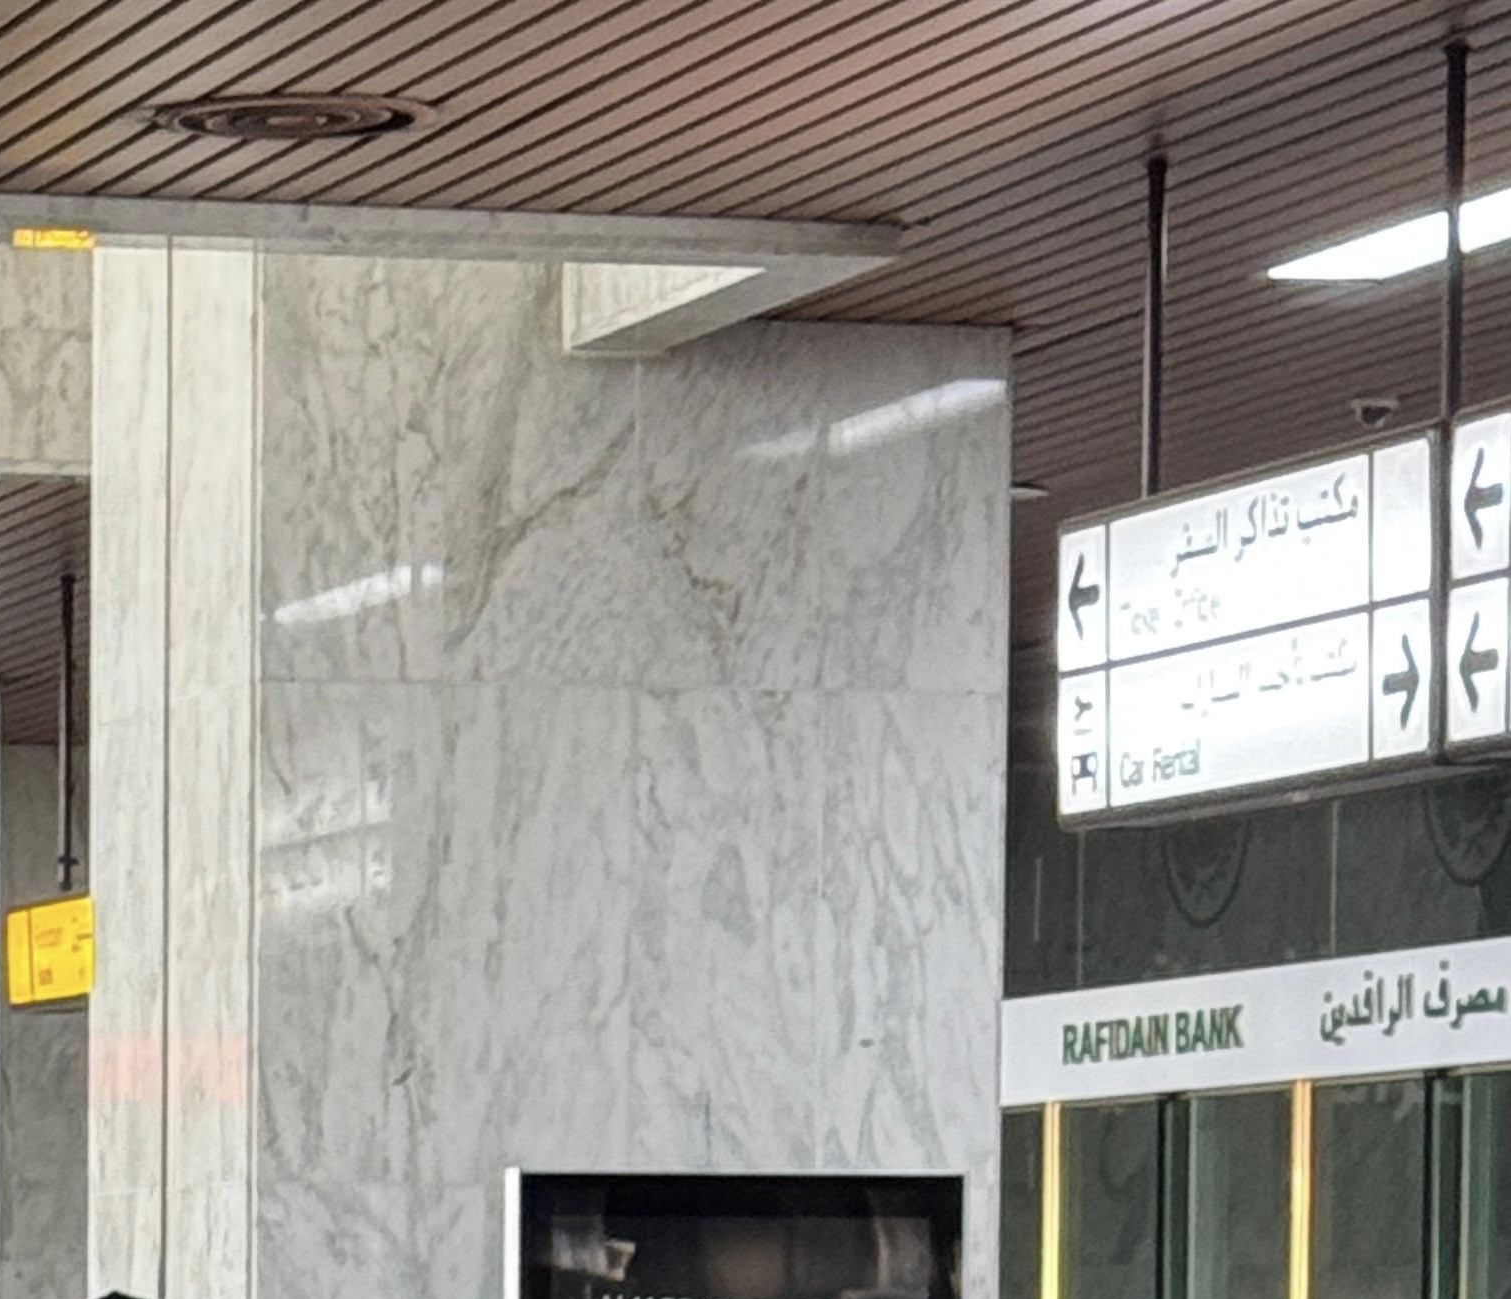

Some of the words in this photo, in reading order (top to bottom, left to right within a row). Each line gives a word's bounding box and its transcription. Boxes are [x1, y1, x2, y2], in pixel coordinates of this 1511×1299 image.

[1320, 969, 1415, 1046] الرافدين
[1423, 960, 1507, 1030] مصرف
[1062, 1011, 1170, 1065] RAFIDAIN
[1175, 1003, 1245, 1055] BANK
